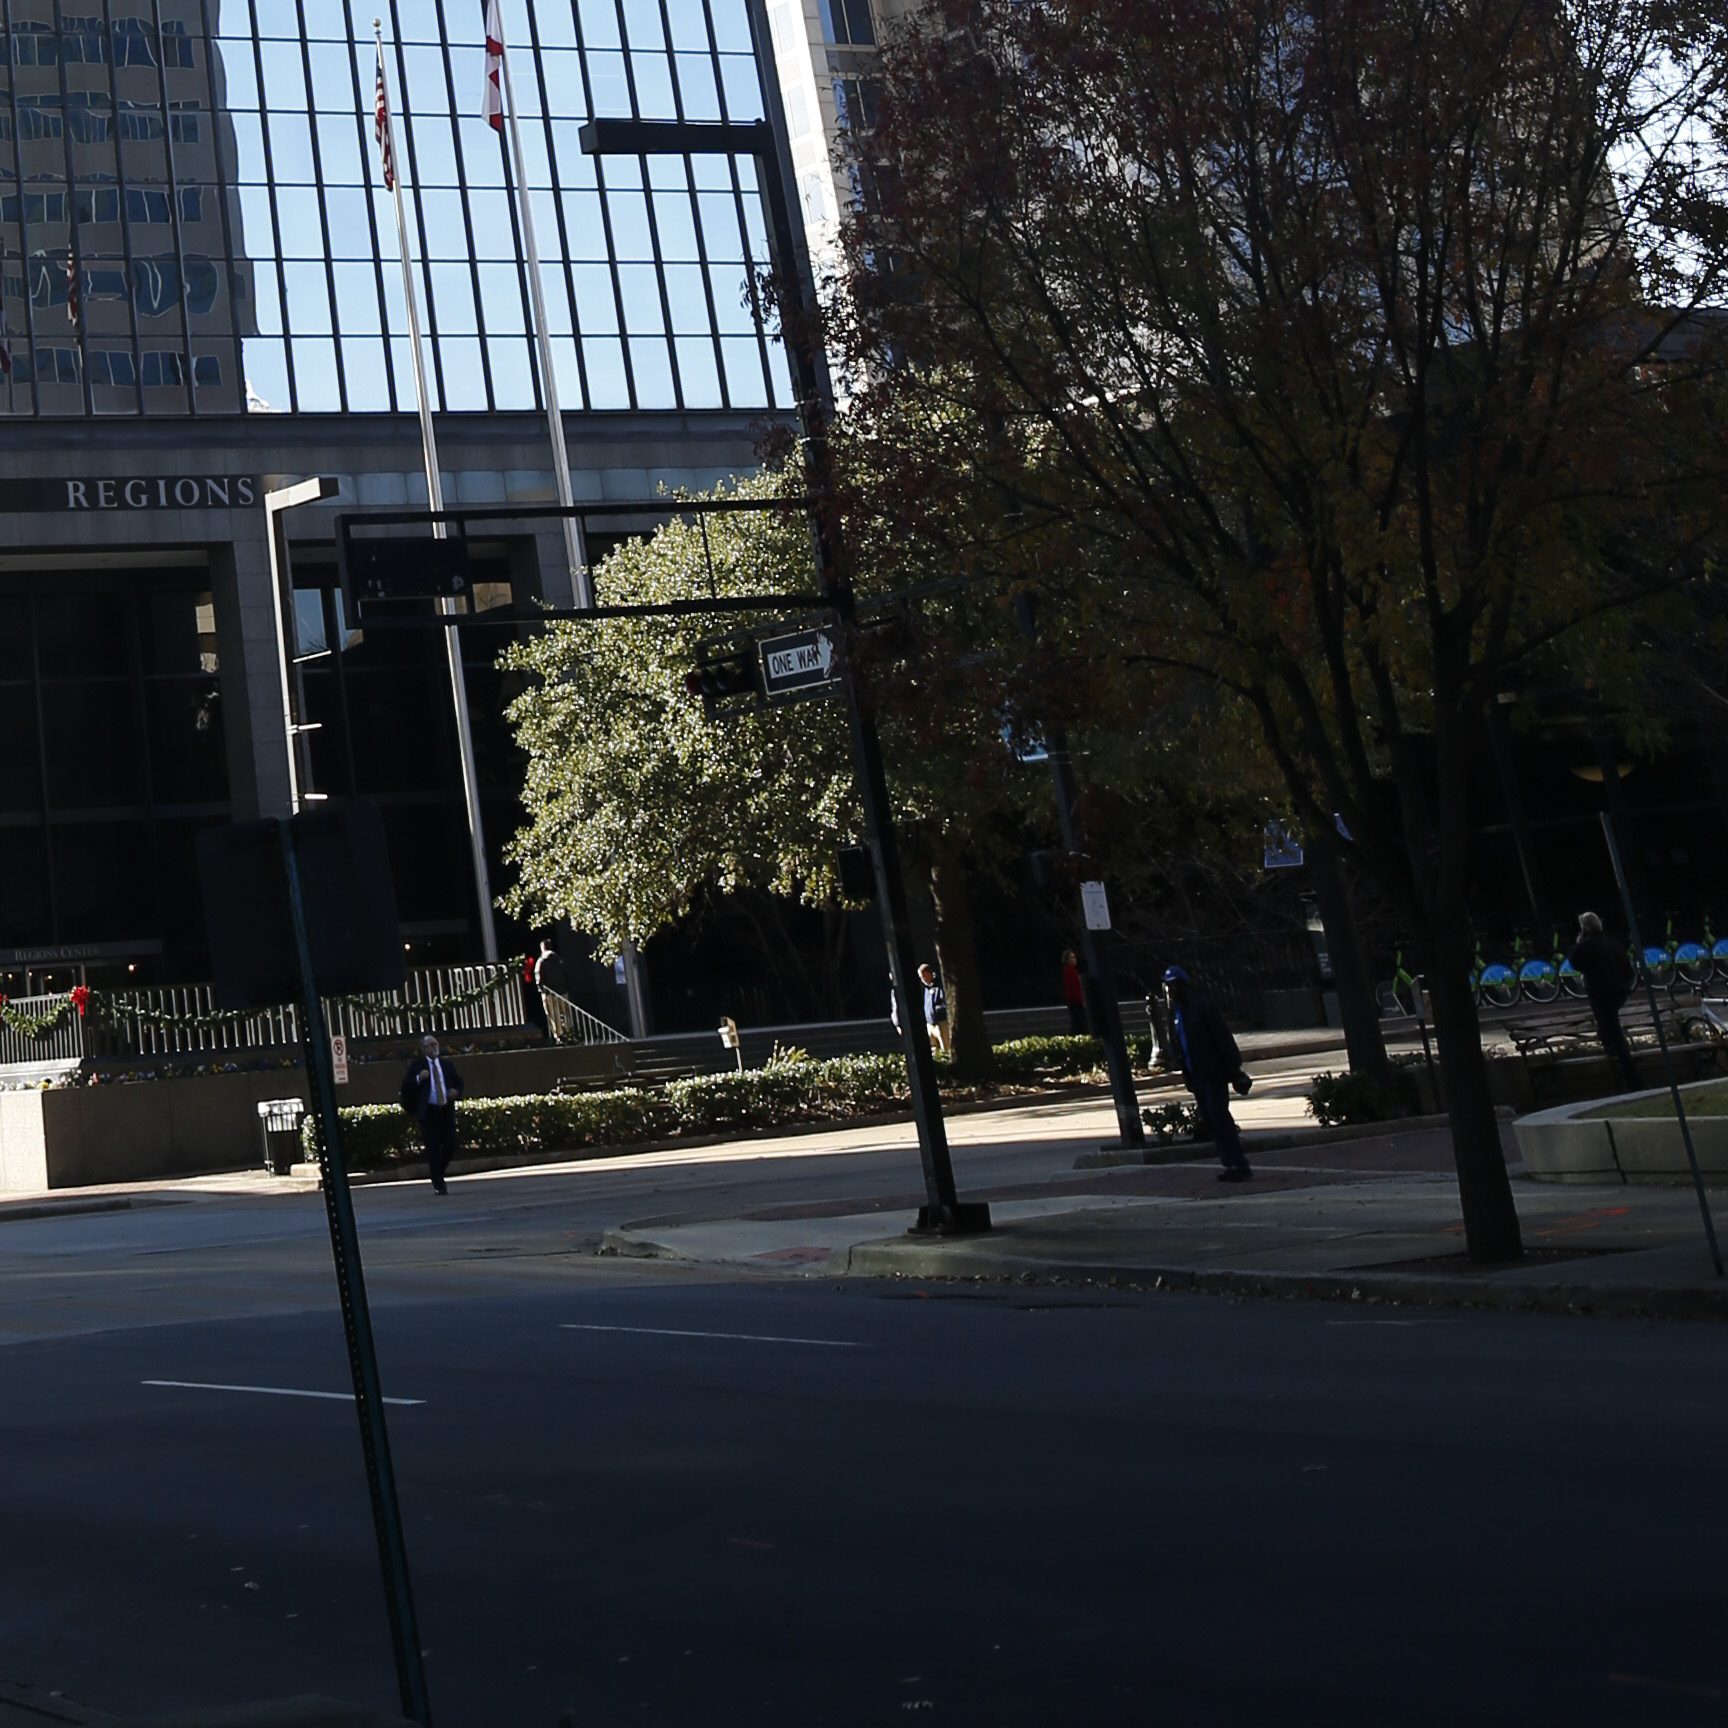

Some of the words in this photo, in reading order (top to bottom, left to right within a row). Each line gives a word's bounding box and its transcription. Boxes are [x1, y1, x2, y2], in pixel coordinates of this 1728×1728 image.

[66, 478, 254, 508] REGIONS
[772, 653, 794, 675] ONE
[796, 646, 821, 669] WAY
